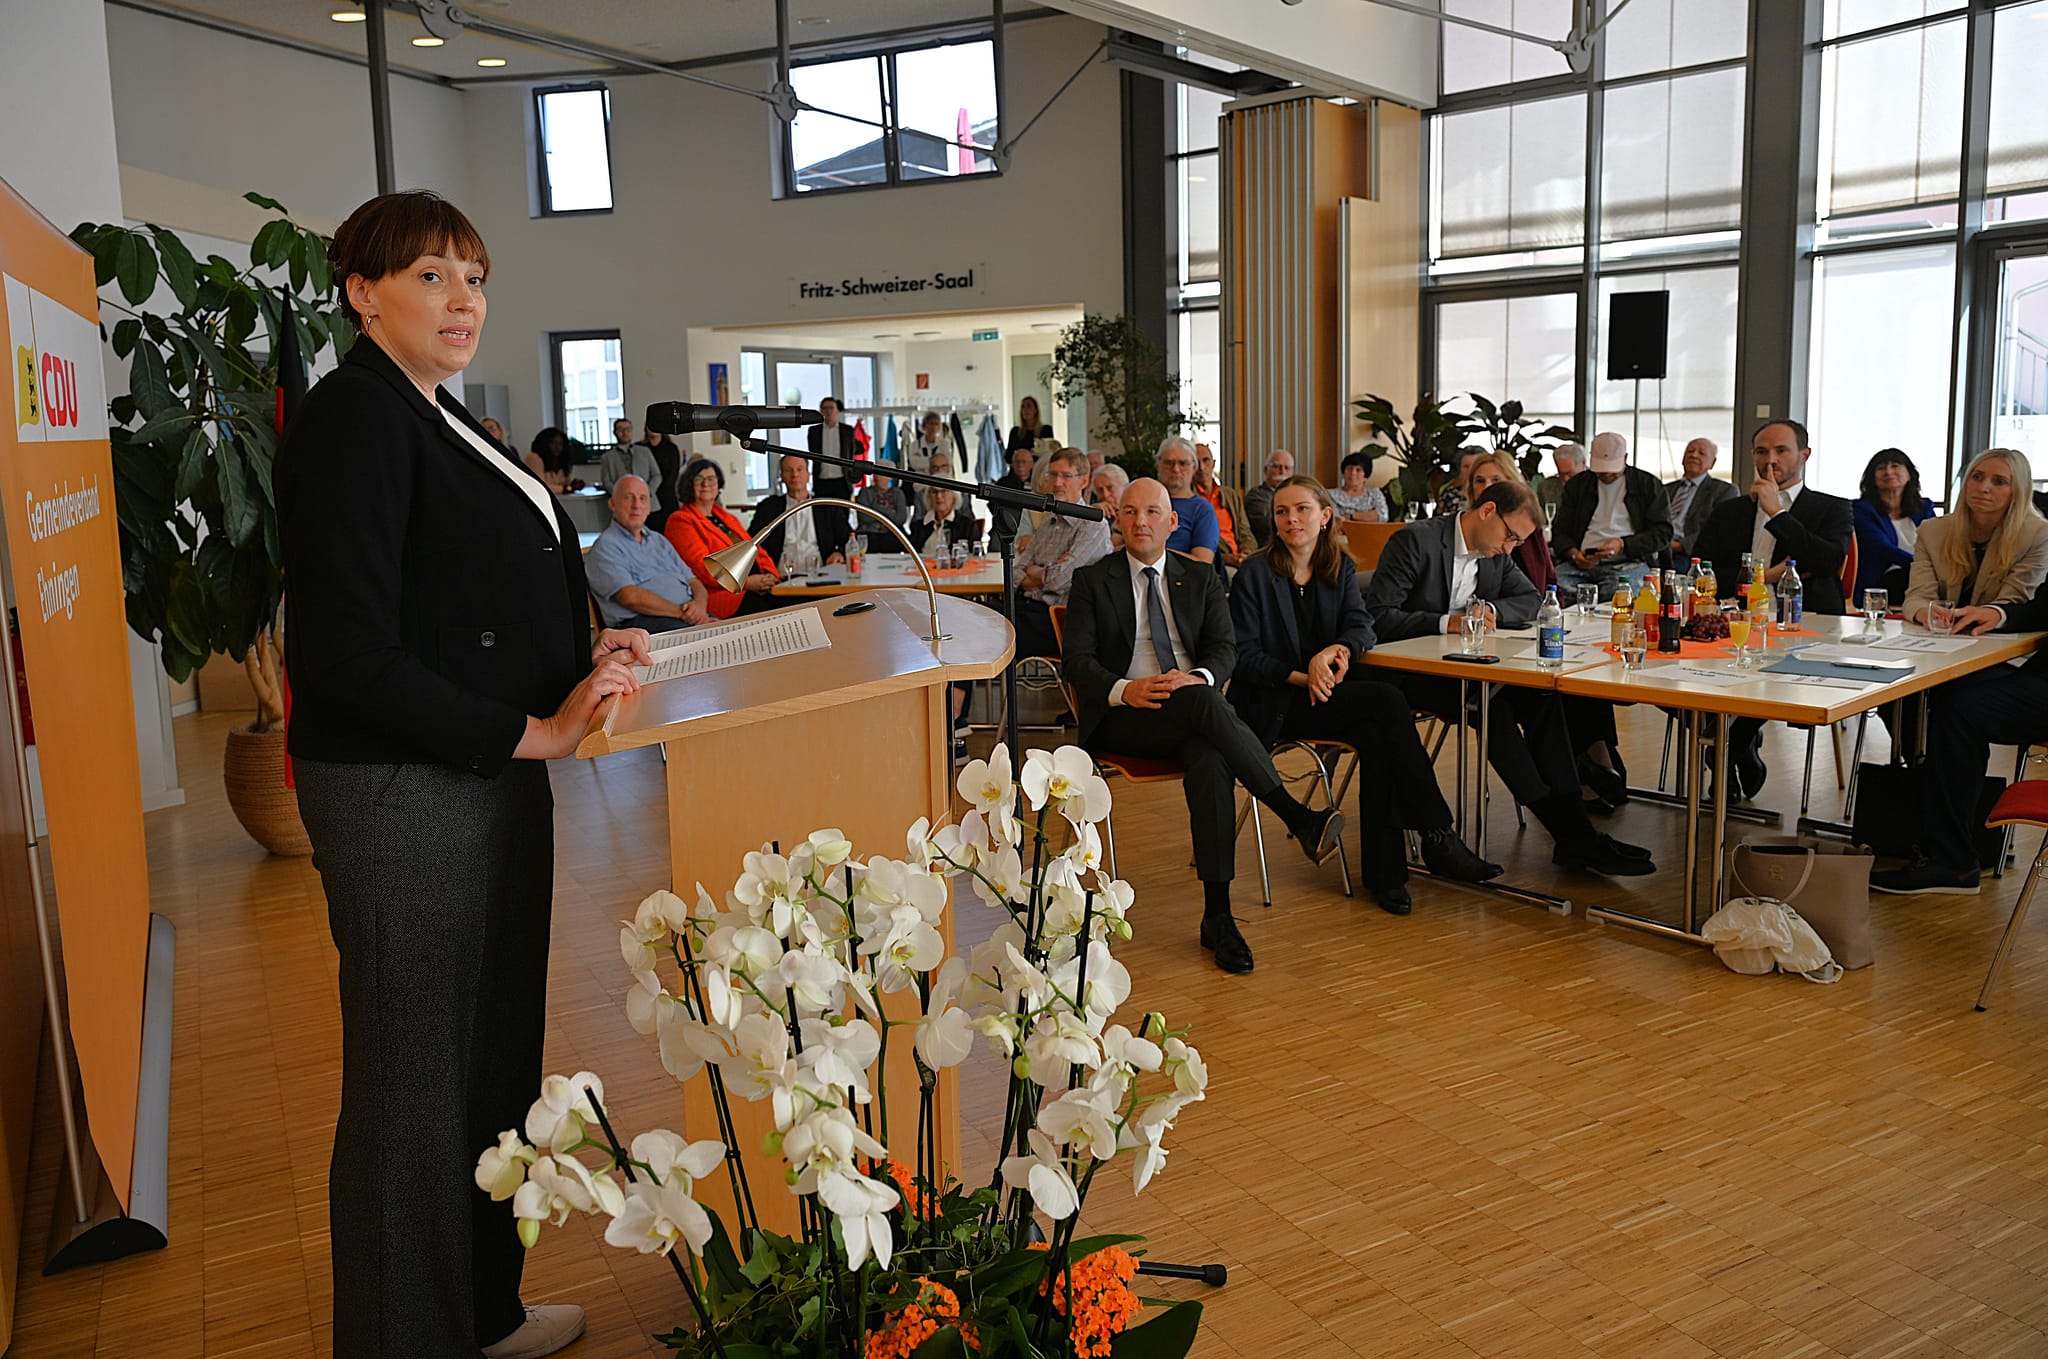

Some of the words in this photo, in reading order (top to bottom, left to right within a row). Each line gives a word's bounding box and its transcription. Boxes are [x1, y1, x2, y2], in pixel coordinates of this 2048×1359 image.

[800, 269, 973, 298] Fritz-Schweizer-Saal
[41, 352, 78, 428] CDU
[26, 473, 100, 543] Gemeindeverband
[37, 561, 80, 624] Ehningen
